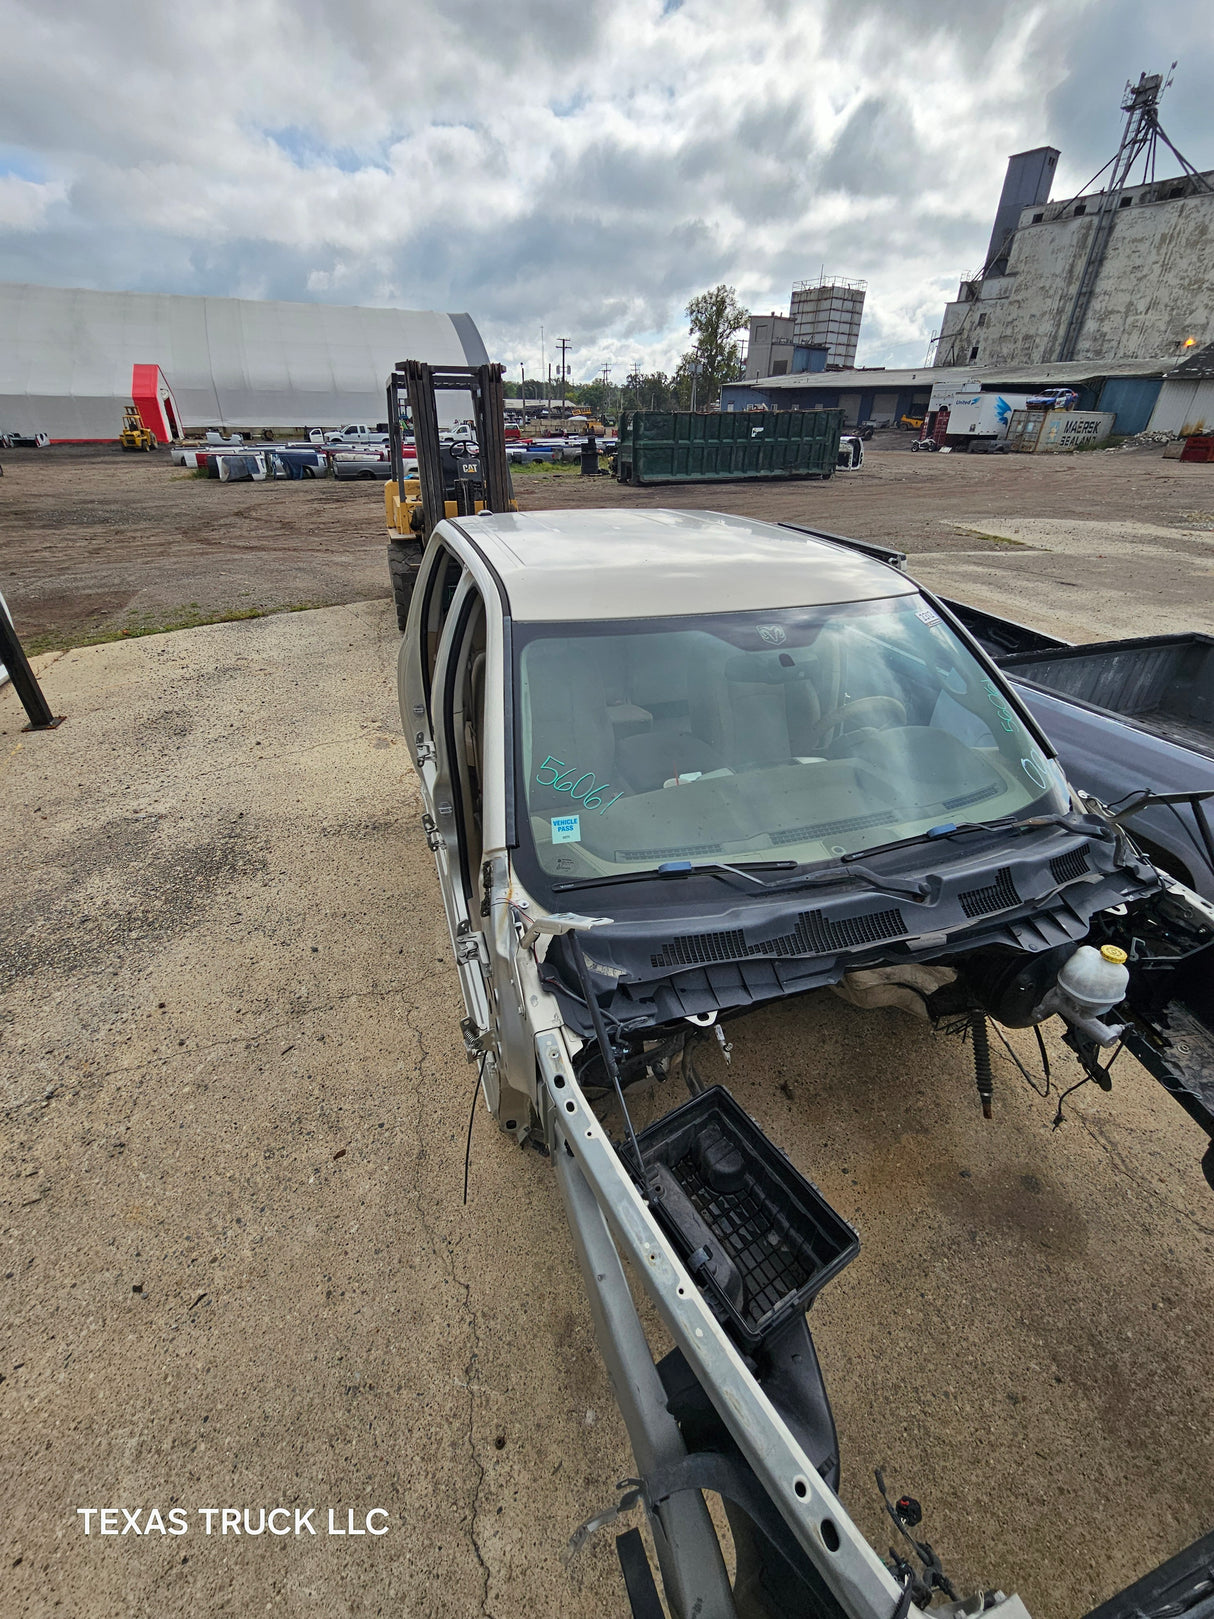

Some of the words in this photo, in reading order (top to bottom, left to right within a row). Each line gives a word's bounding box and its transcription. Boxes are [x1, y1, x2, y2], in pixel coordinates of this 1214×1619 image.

[1063, 420, 1101, 434] MAERSK
[462, 464, 478, 473] CAT
[536, 755, 624, 815] 56061
[552, 818, 578, 827] VEHICLE
